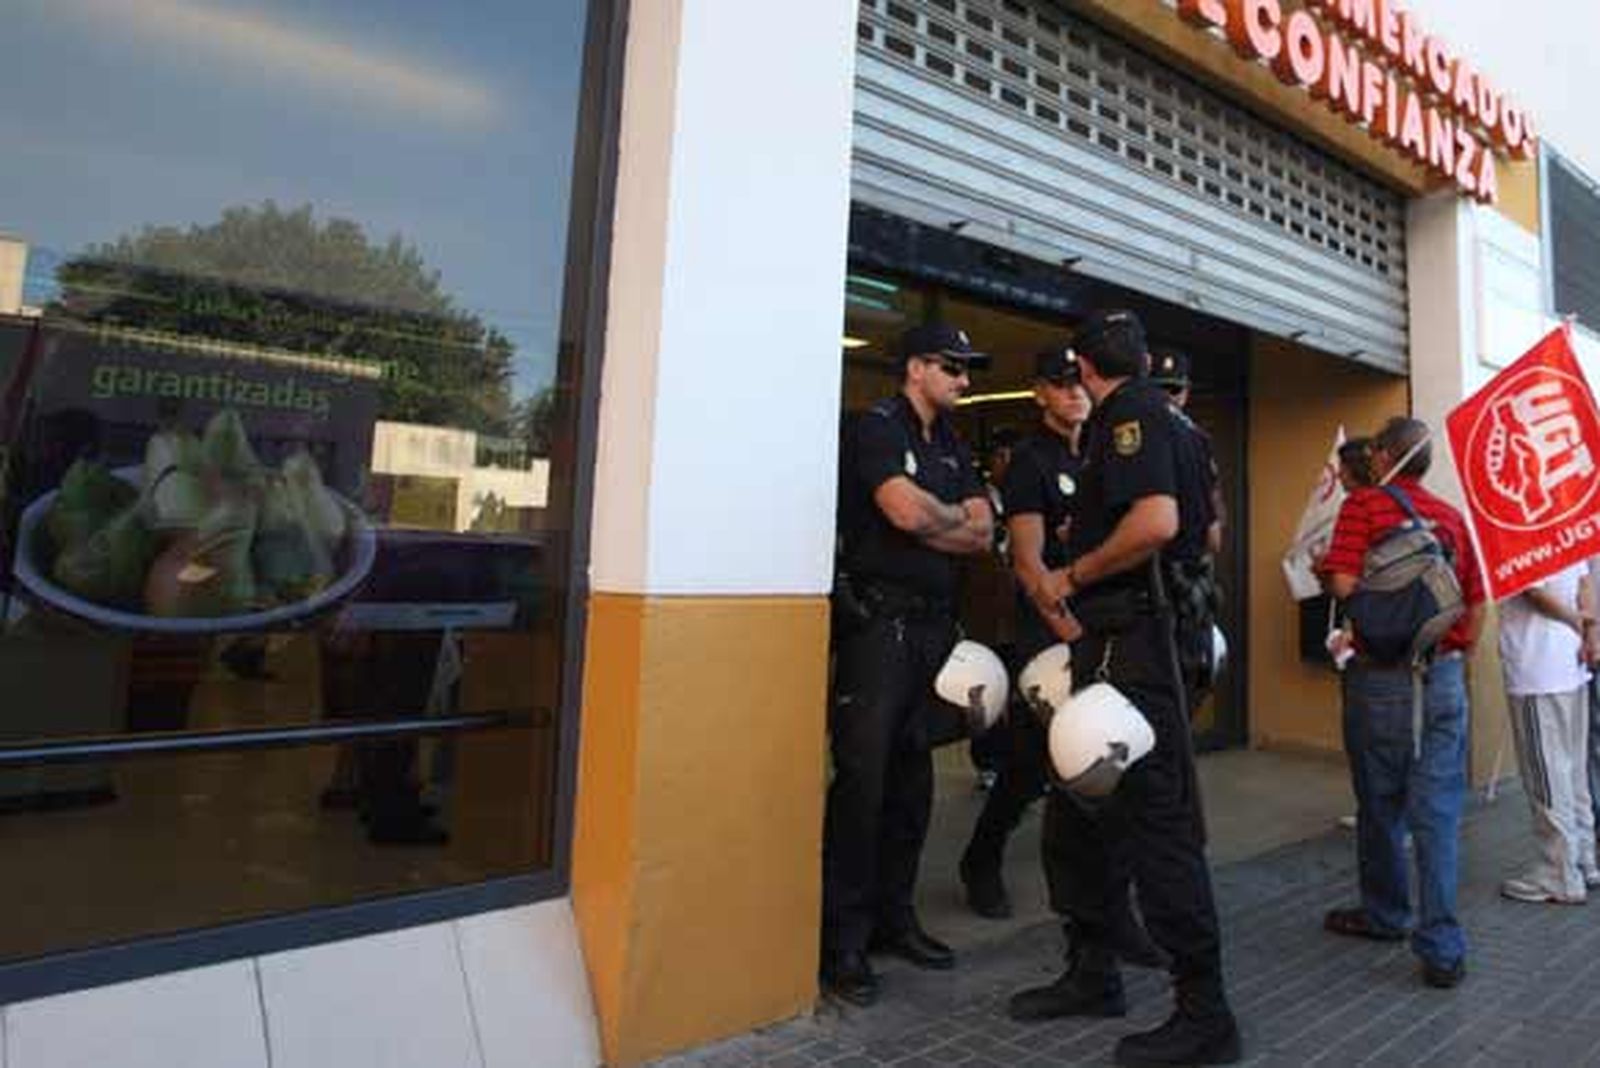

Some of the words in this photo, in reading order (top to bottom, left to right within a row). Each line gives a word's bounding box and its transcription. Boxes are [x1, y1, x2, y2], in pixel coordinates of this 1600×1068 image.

[1244, 0, 1498, 203] CONFIANZA
[1327, 0, 1537, 159] MERCADOS
[92, 363, 330, 418] garantizadas
